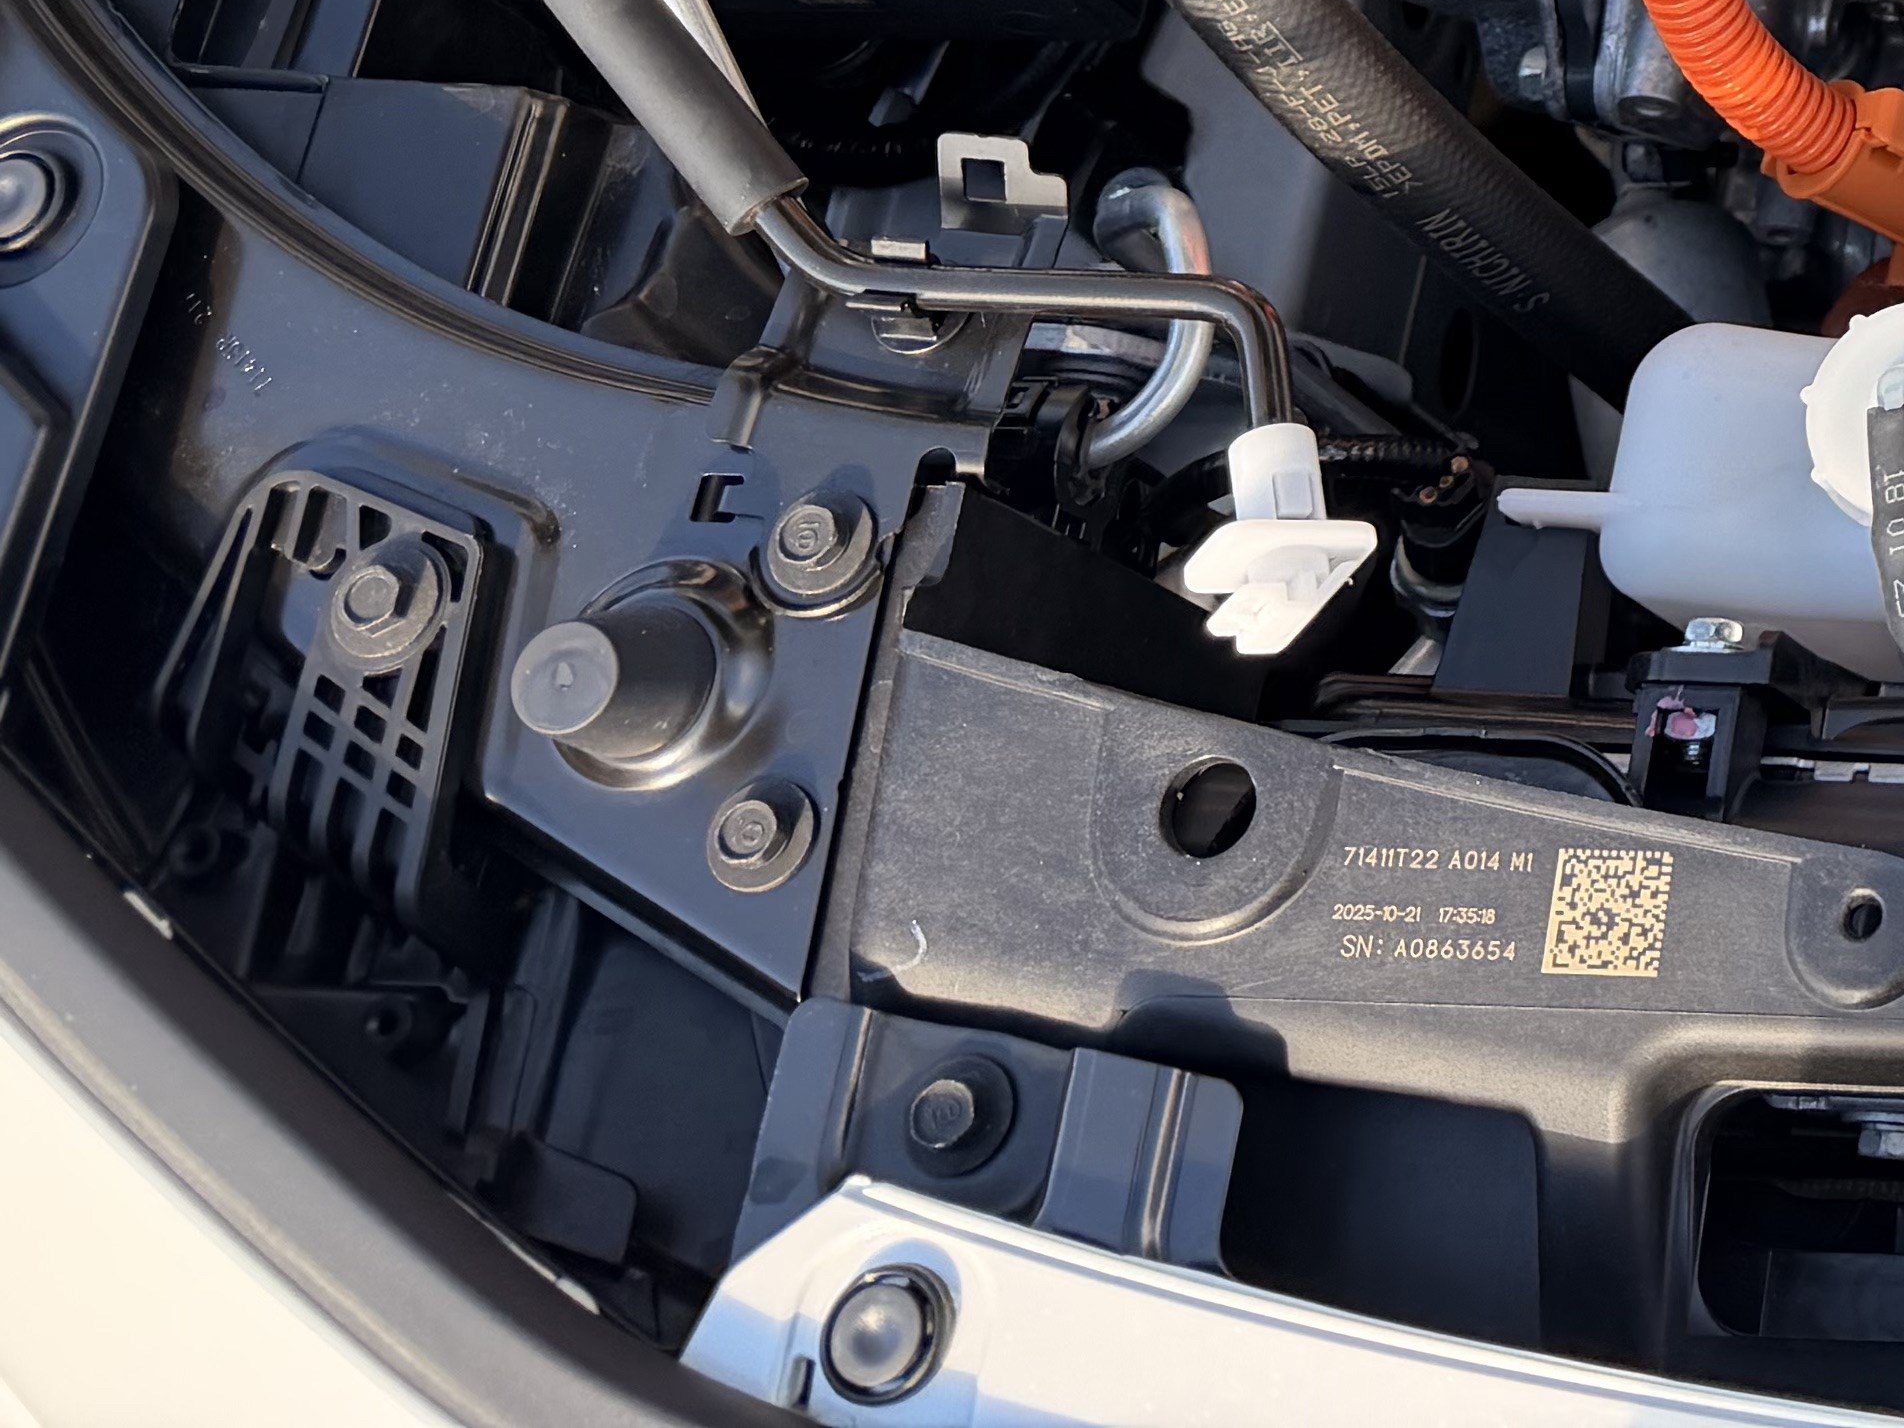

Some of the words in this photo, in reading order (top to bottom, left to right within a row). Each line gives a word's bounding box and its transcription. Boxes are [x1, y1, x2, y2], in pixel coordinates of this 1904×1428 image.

[1343, 846, 1439, 870] 71411T22
[1448, 850, 1500, 871] A014
[1510, 852, 1534, 872] M1
[1332, 904, 1421, 922] 2025-10-21
[1438, 907, 1496, 925] 17:35:18
[1341, 935, 1384, 958] SN:
[1394, 938, 1516, 961] A0863654
